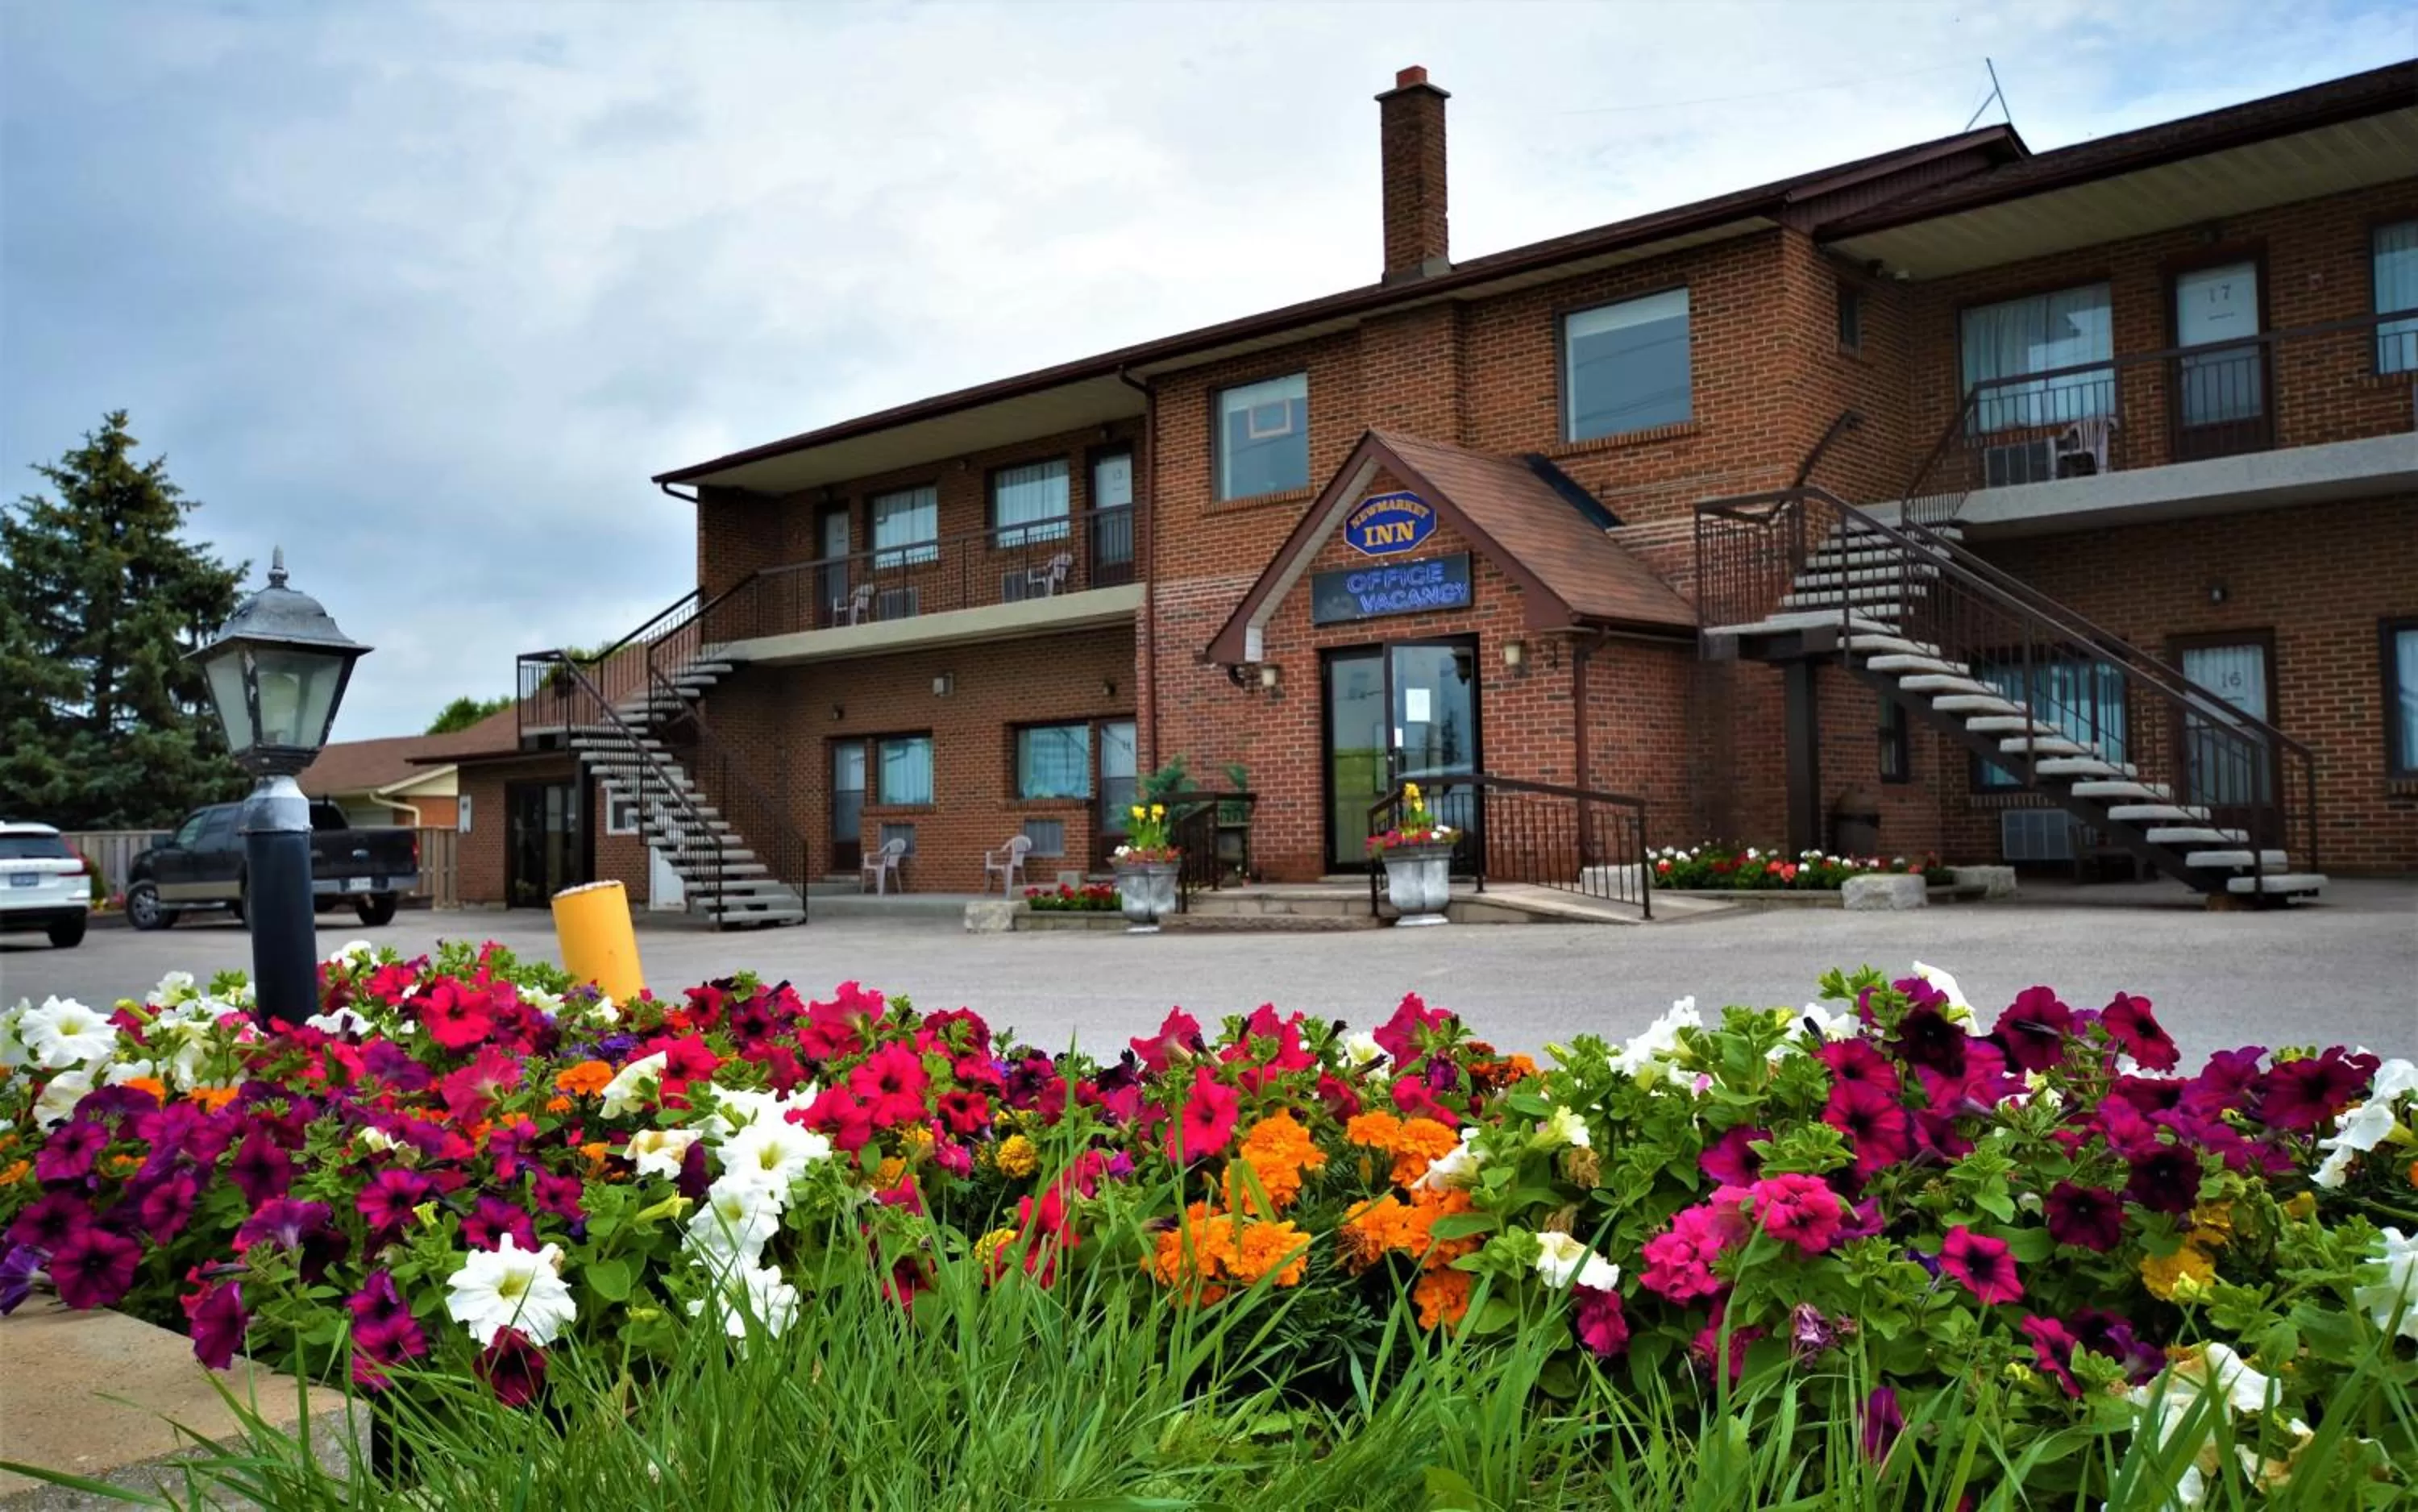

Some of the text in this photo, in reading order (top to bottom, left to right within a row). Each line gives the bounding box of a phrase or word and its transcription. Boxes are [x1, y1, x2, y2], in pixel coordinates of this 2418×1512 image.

[2209, 284, 2231, 302] 17
[1364, 520, 1415, 546] INN
[1347, 563, 1444, 593] OFFICE
[1360, 582, 1468, 613] VACANCY
